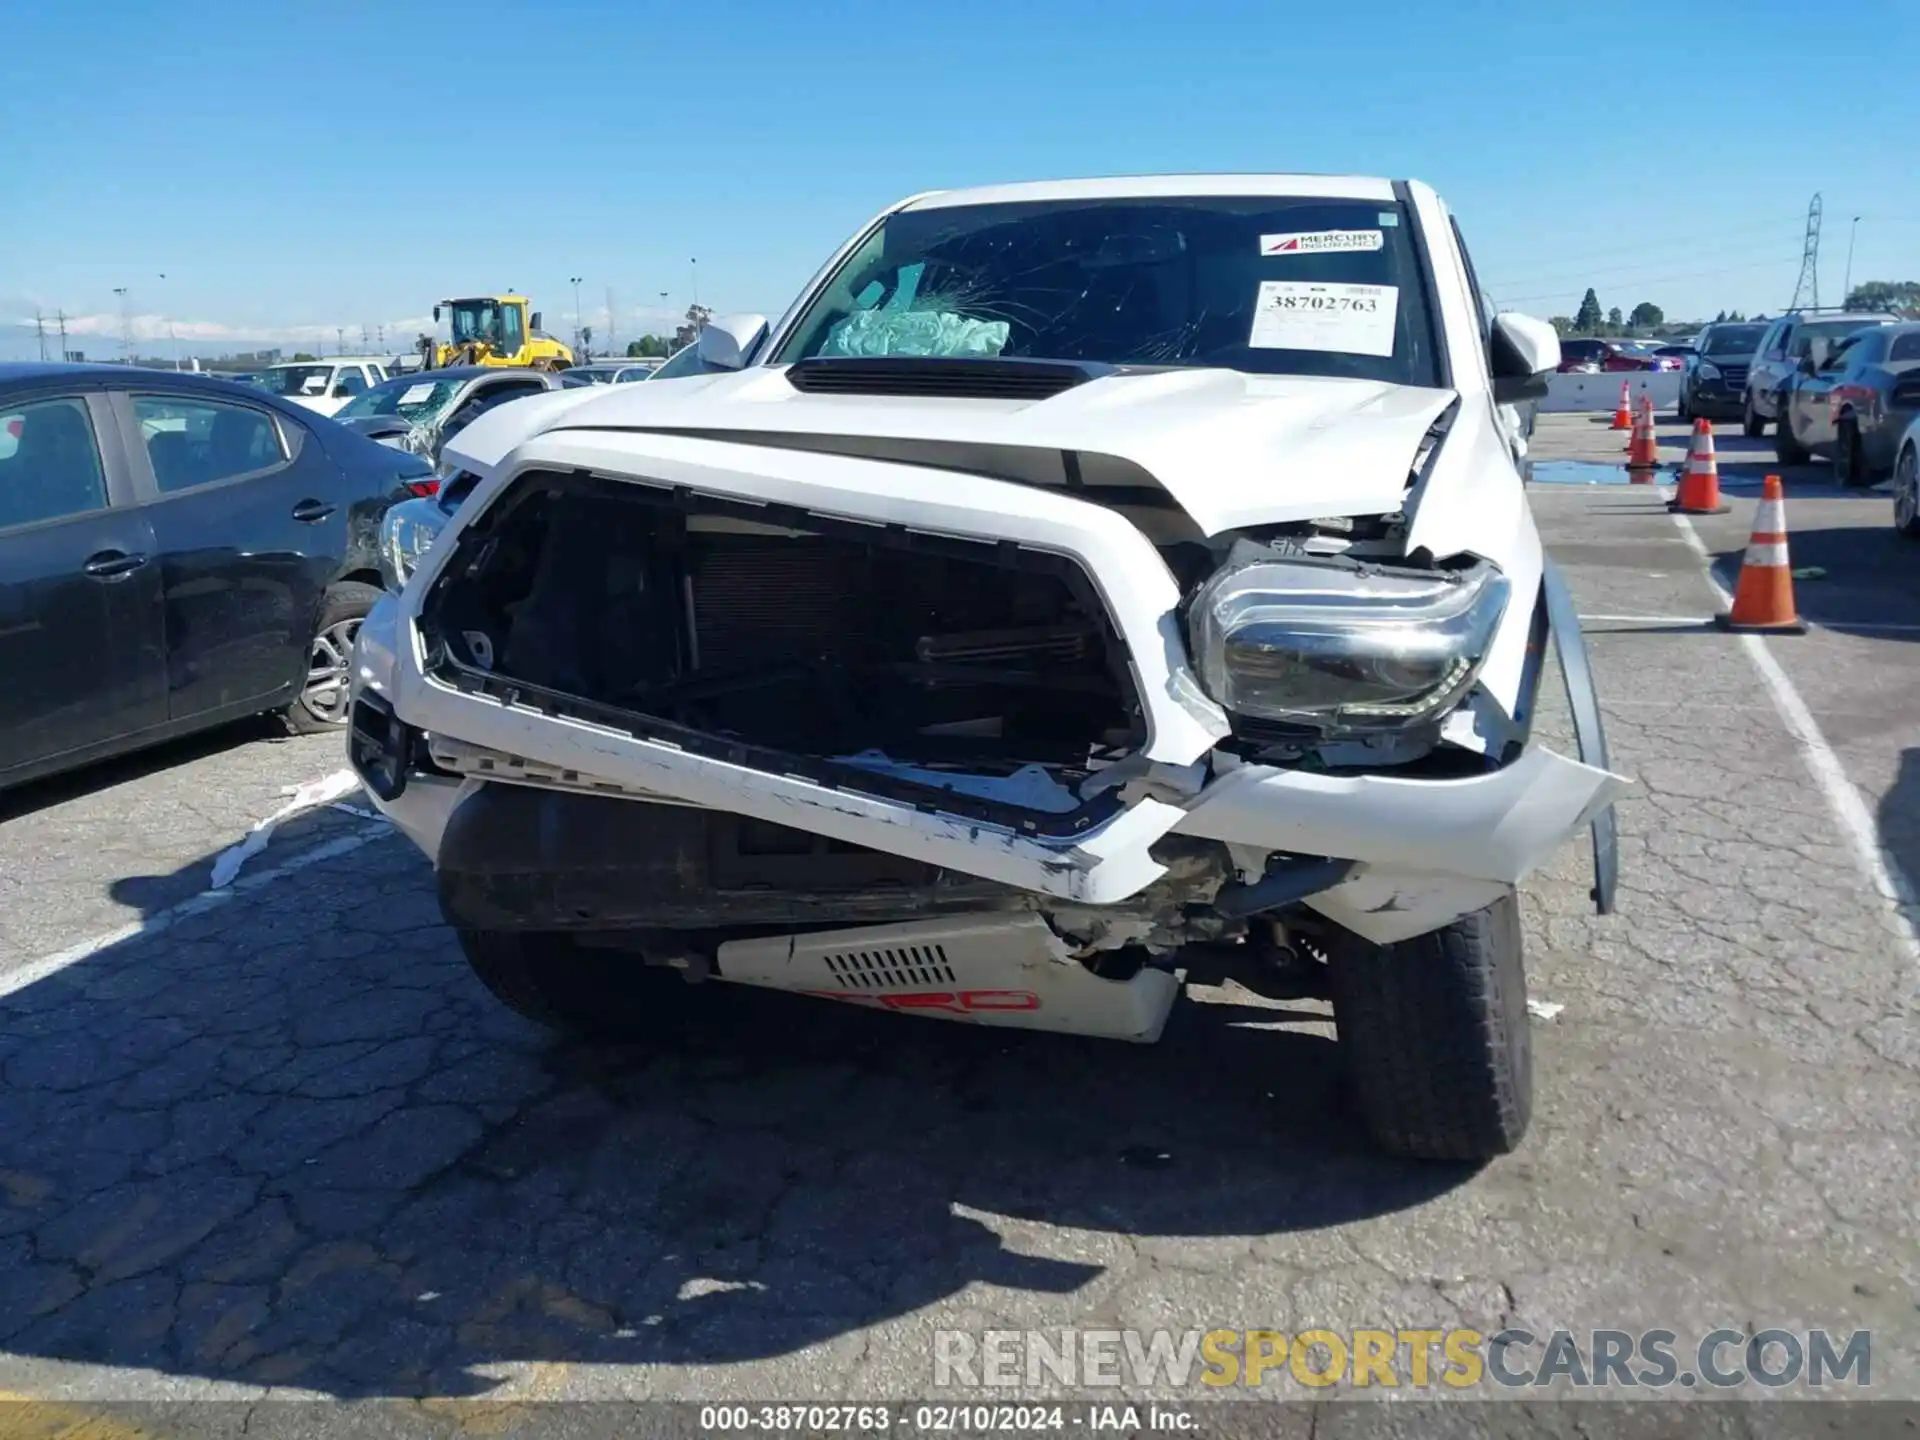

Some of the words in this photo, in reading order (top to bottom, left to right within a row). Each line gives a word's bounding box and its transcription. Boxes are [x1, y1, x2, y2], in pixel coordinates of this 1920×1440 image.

[1300, 234, 1378, 243] MERCURY
[1300, 241, 1378, 249] INSURANCE
[1270, 296, 1377, 313] 38702763
